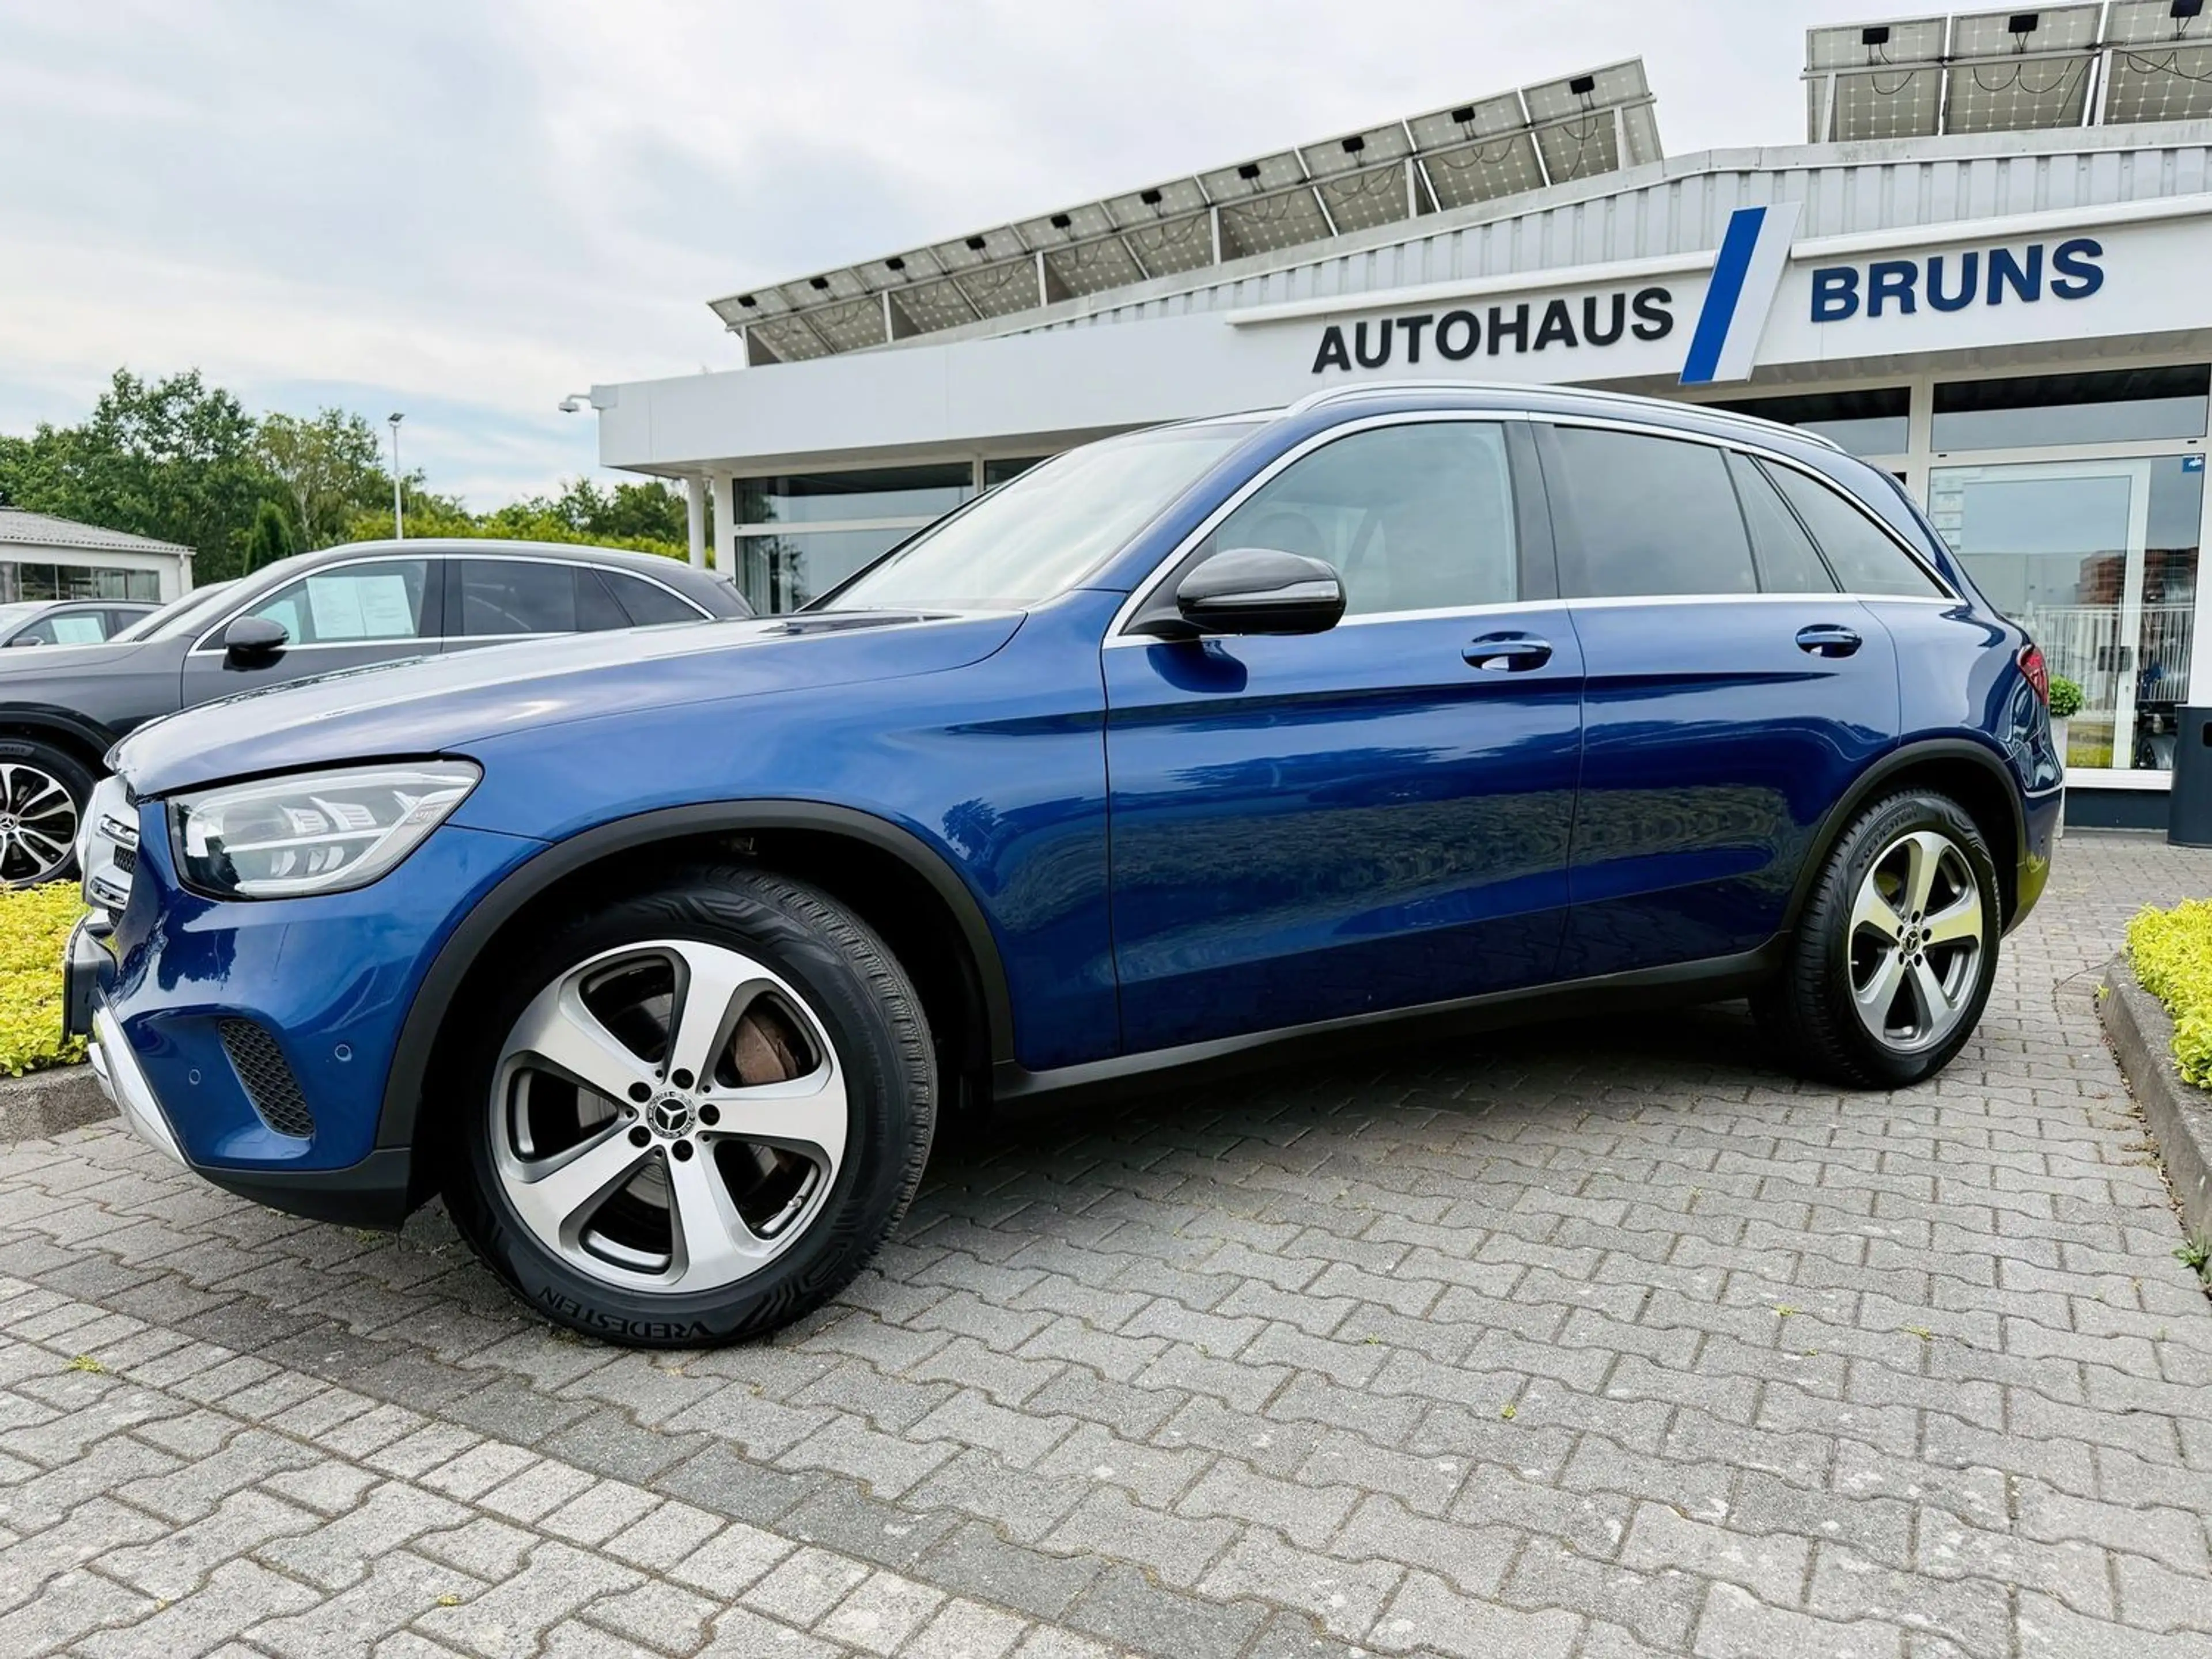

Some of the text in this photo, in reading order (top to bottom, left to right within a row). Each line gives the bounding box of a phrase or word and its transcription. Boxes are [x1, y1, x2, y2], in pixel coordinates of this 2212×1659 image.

[1312, 238, 2104, 374] AUTOHAUS BRUNS
[537, 1285, 714, 1339] VREDESTEIN
